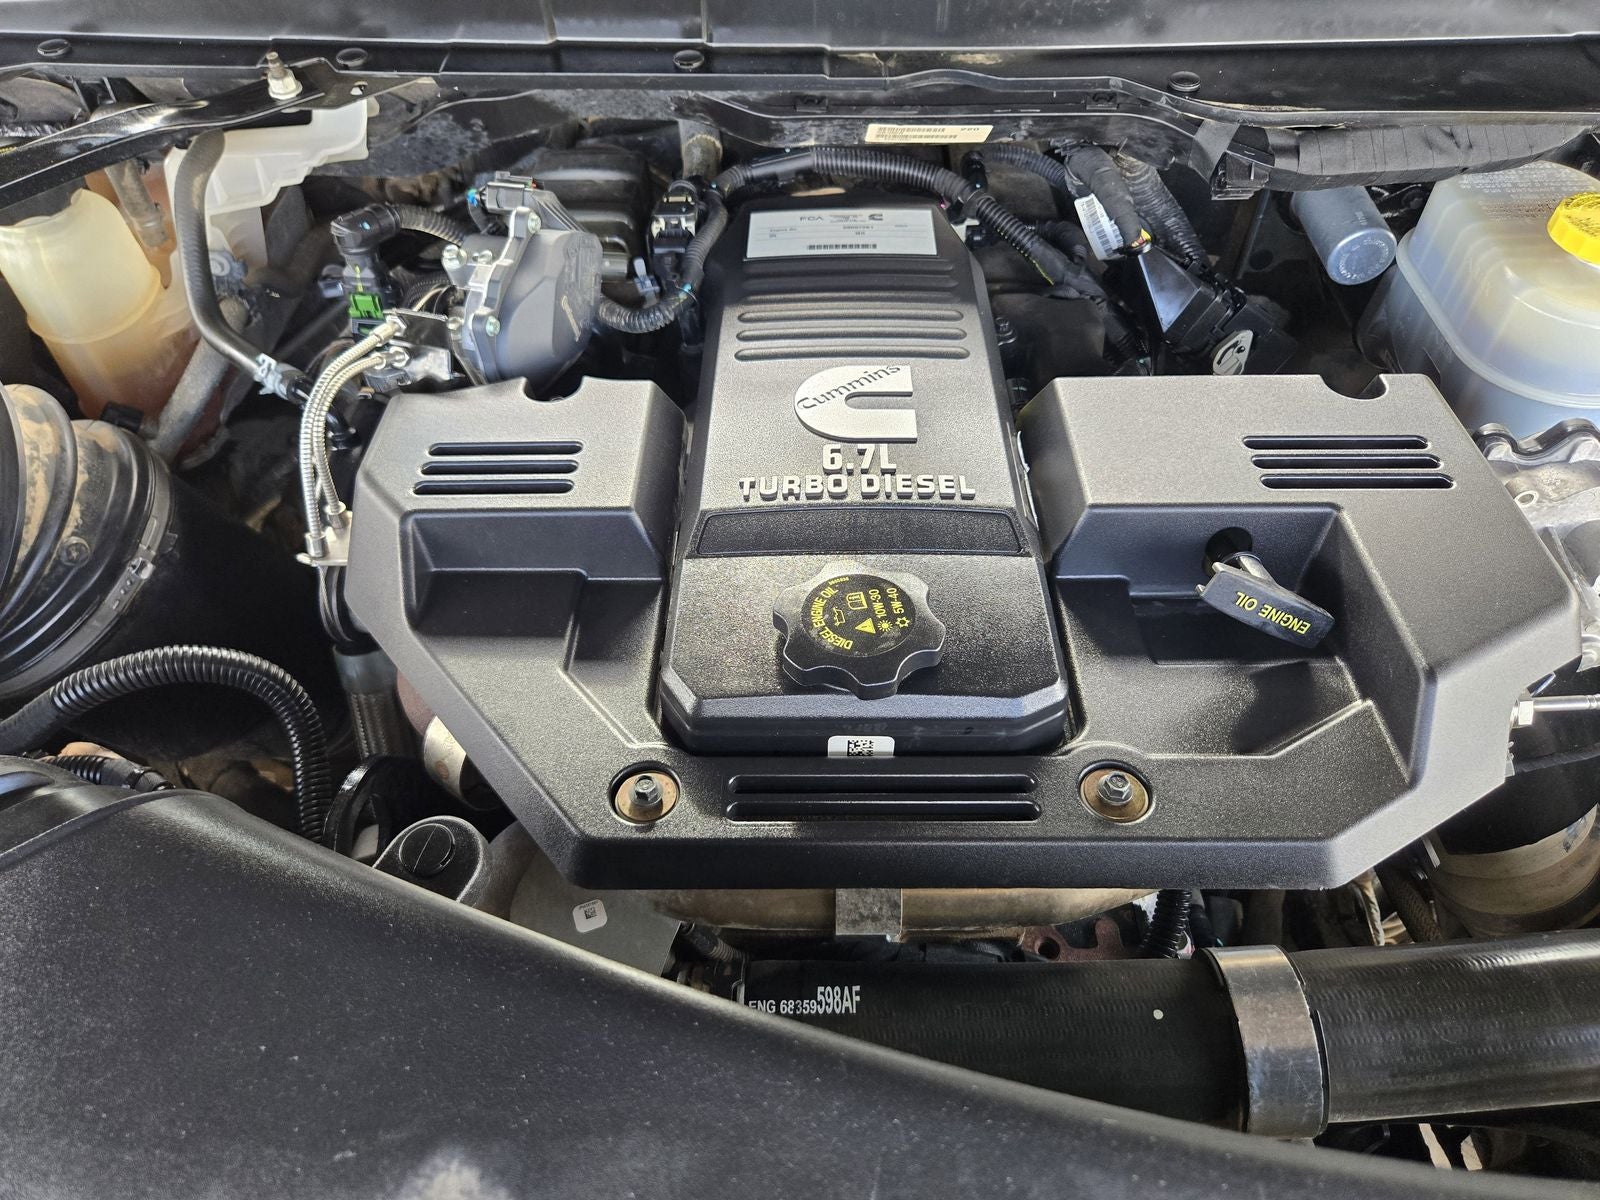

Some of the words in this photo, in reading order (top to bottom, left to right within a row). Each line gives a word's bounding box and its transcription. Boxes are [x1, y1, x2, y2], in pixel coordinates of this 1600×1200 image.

[796, 365, 901, 410] Cummins
[822, 443, 897, 474] 6.7L
[739, 474, 848, 501] TURBO
[860, 474, 976, 501] DIESEL
[820, 586, 839, 599] OIL
[868, 588, 887, 619] 10W-30
[886, 587, 905, 615] 5W-40
[1234, 591, 1258, 611] OIL
[810, 597, 828, 628] ENGINE
[1257, 603, 1312, 635] ENGINE
[819, 626, 854, 650] DIESEL
